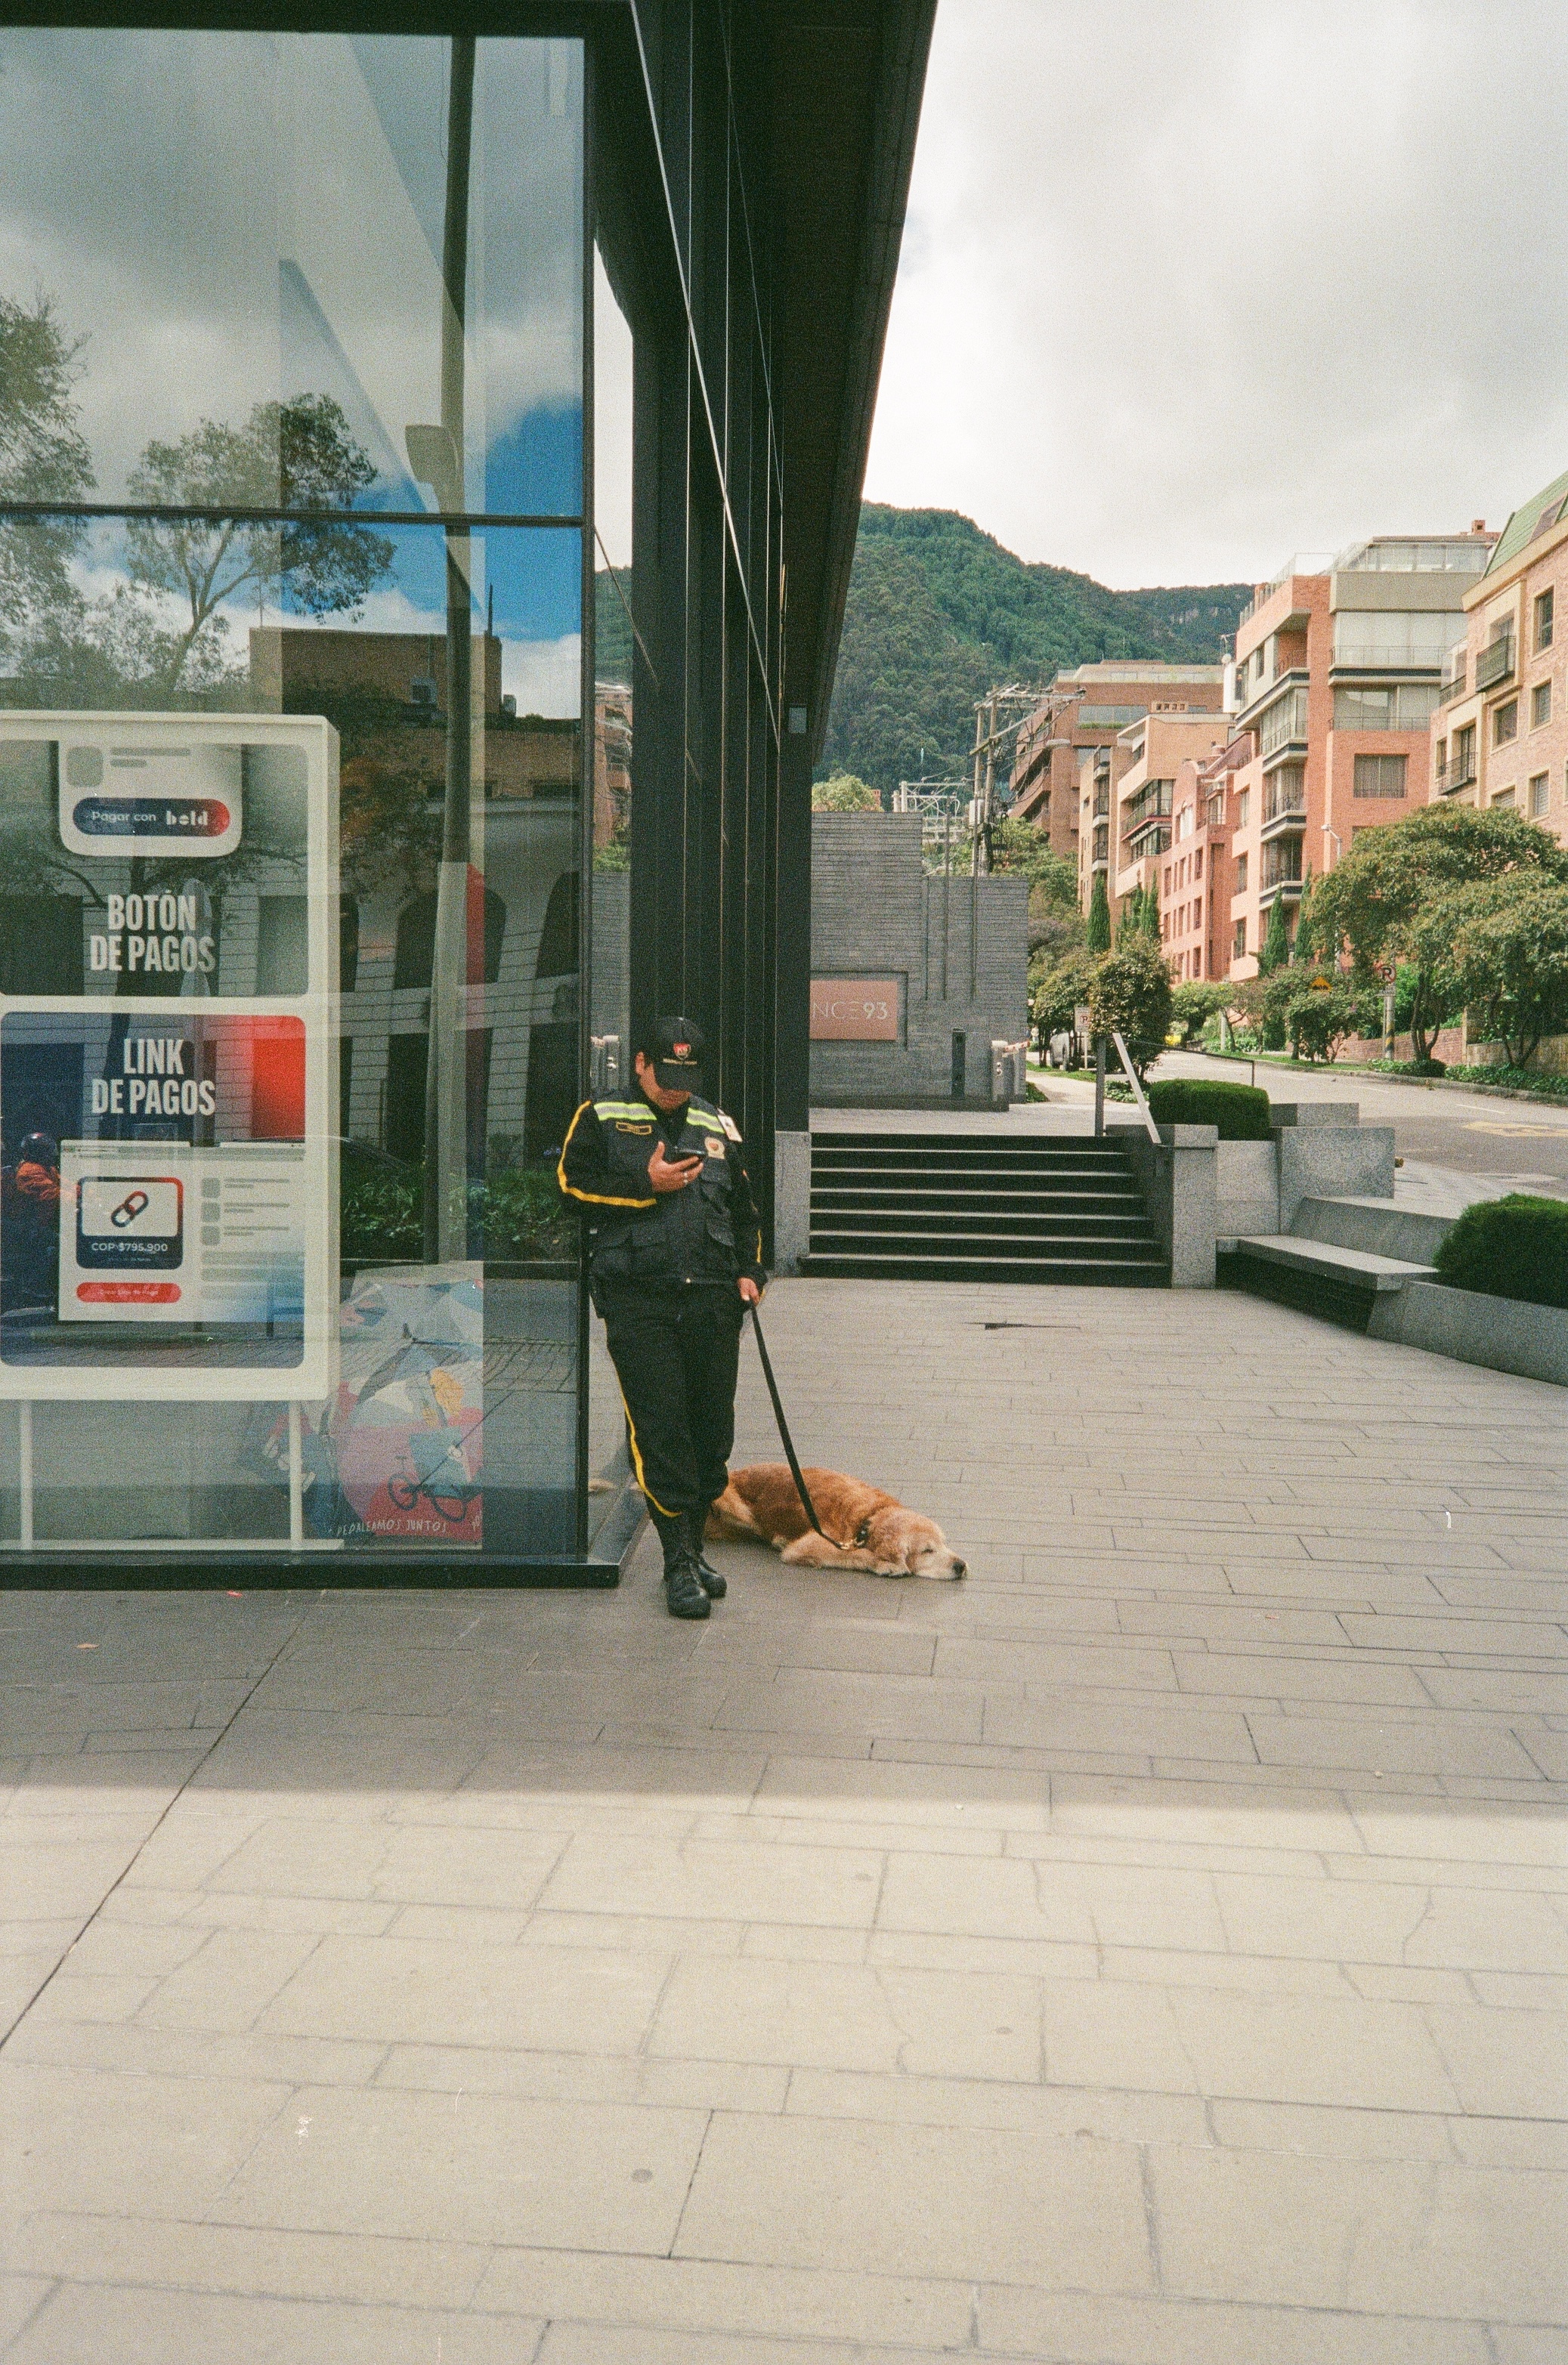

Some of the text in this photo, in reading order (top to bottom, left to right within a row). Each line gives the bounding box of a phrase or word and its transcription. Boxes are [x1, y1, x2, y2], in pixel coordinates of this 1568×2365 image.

[92, 812, 130, 822] Pagar
[134, 813, 156, 821] con
[107, 889, 196, 931] BOTÓN
[90, 935, 216, 972] DE PAGOS
[124, 1038, 184, 1074] LINK
[91, 1079, 216, 1116] DE PAGOS
[91, 1241, 168, 1252] COP $795.900
[406, 1519, 446, 1533] JUNTOS
